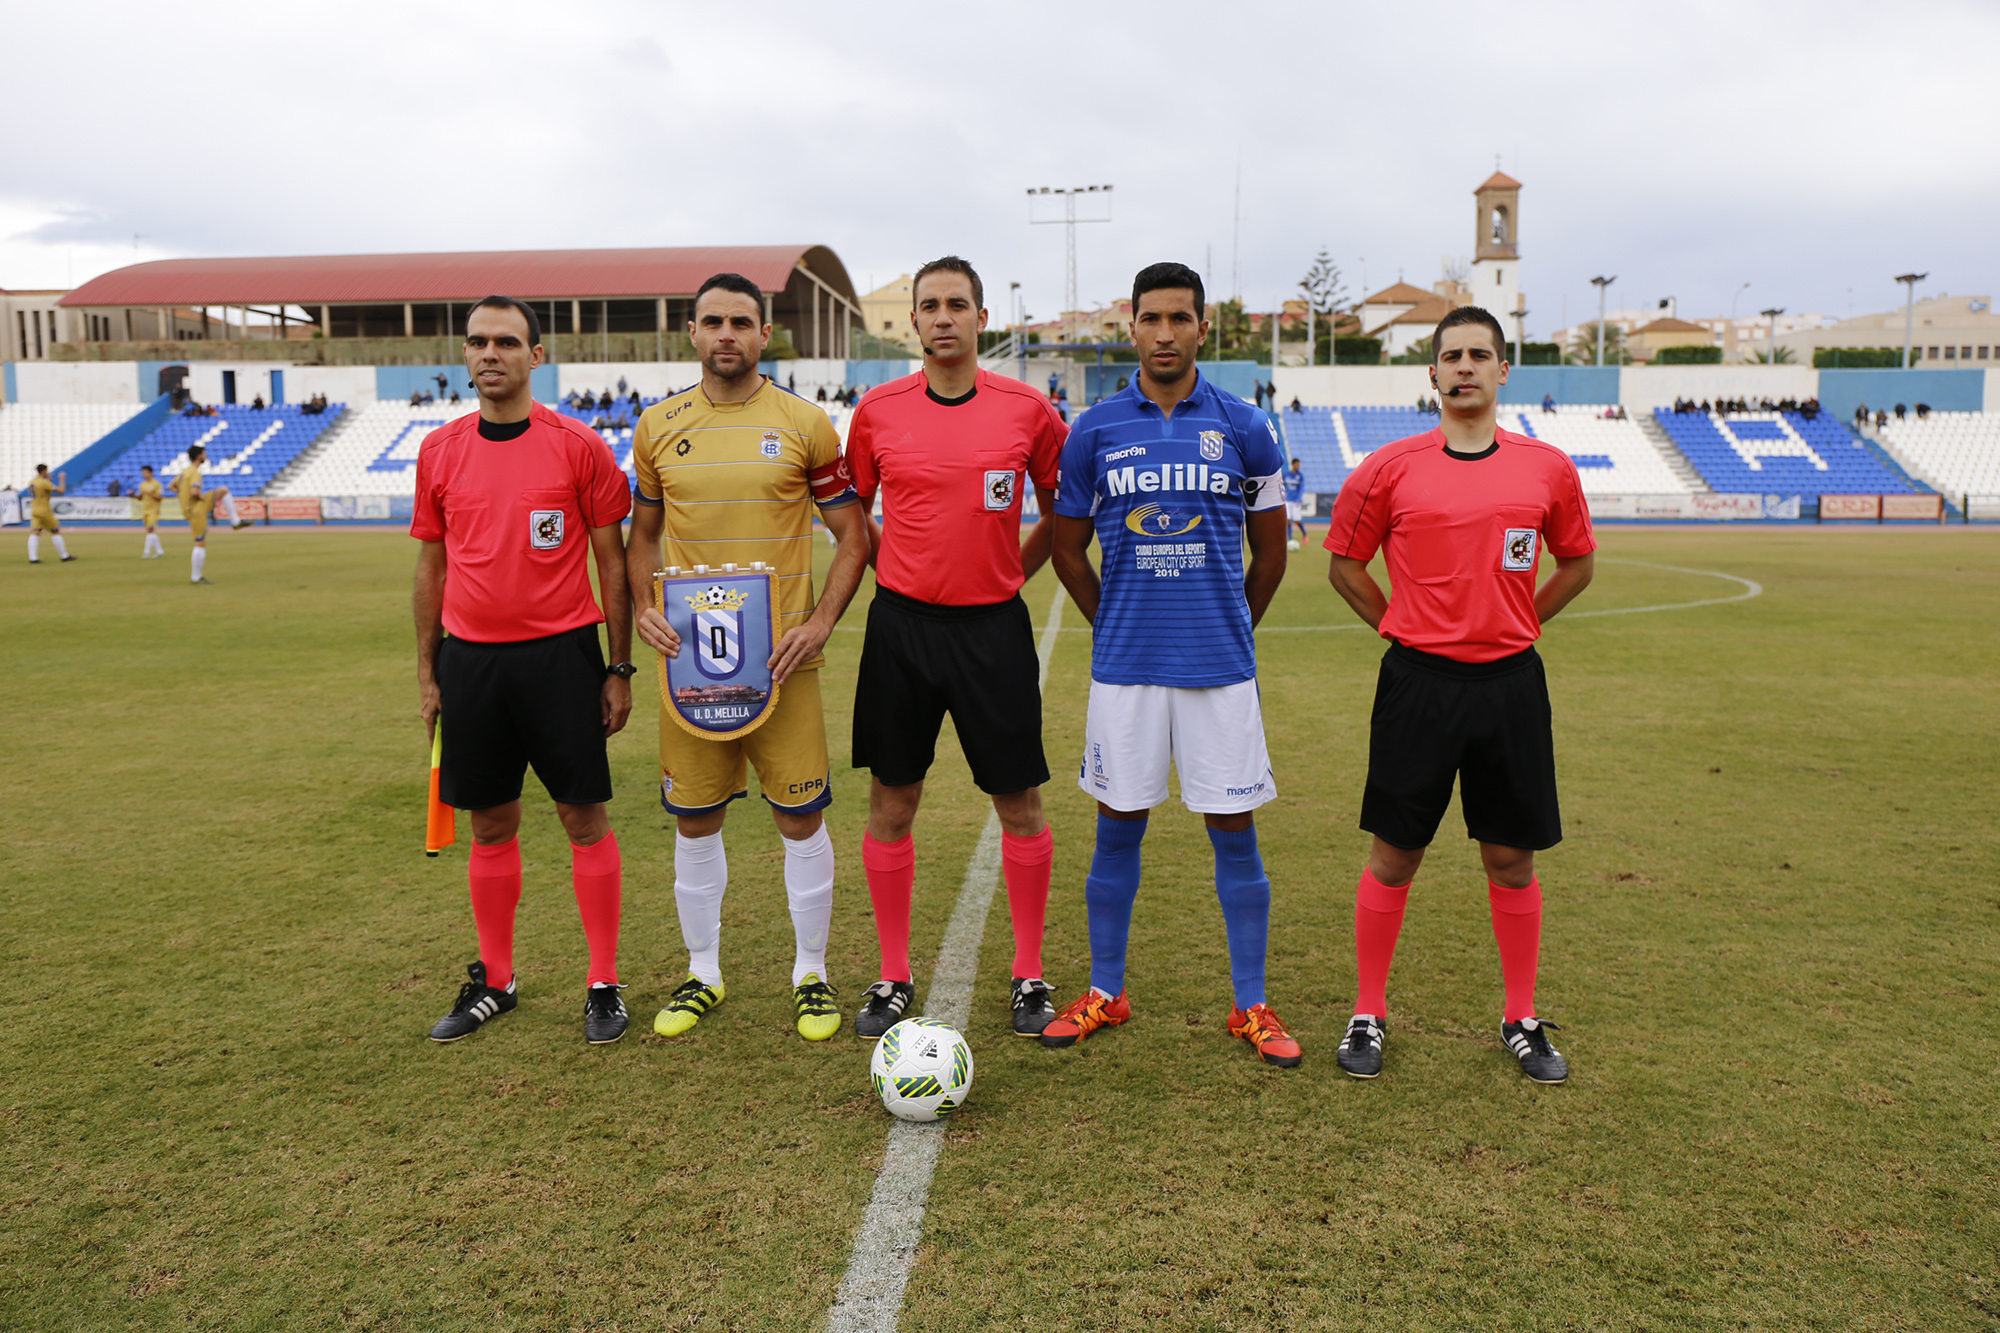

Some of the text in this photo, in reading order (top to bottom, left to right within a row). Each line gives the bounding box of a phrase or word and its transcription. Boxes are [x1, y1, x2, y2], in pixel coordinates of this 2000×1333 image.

[1105, 446, 1146, 463] macron
[1106, 463, 1230, 497] Melilla
[1135, 543, 1206, 556] CIUDAD EUROPEA DEL DEPORTE
[1137, 555, 1206, 569] EUROPEAN CITY OF SPORT
[1154, 569, 1180, 578] 2016
[694, 706, 750, 720] U. D. MELILLA
[1227, 782, 1265, 797] macron
